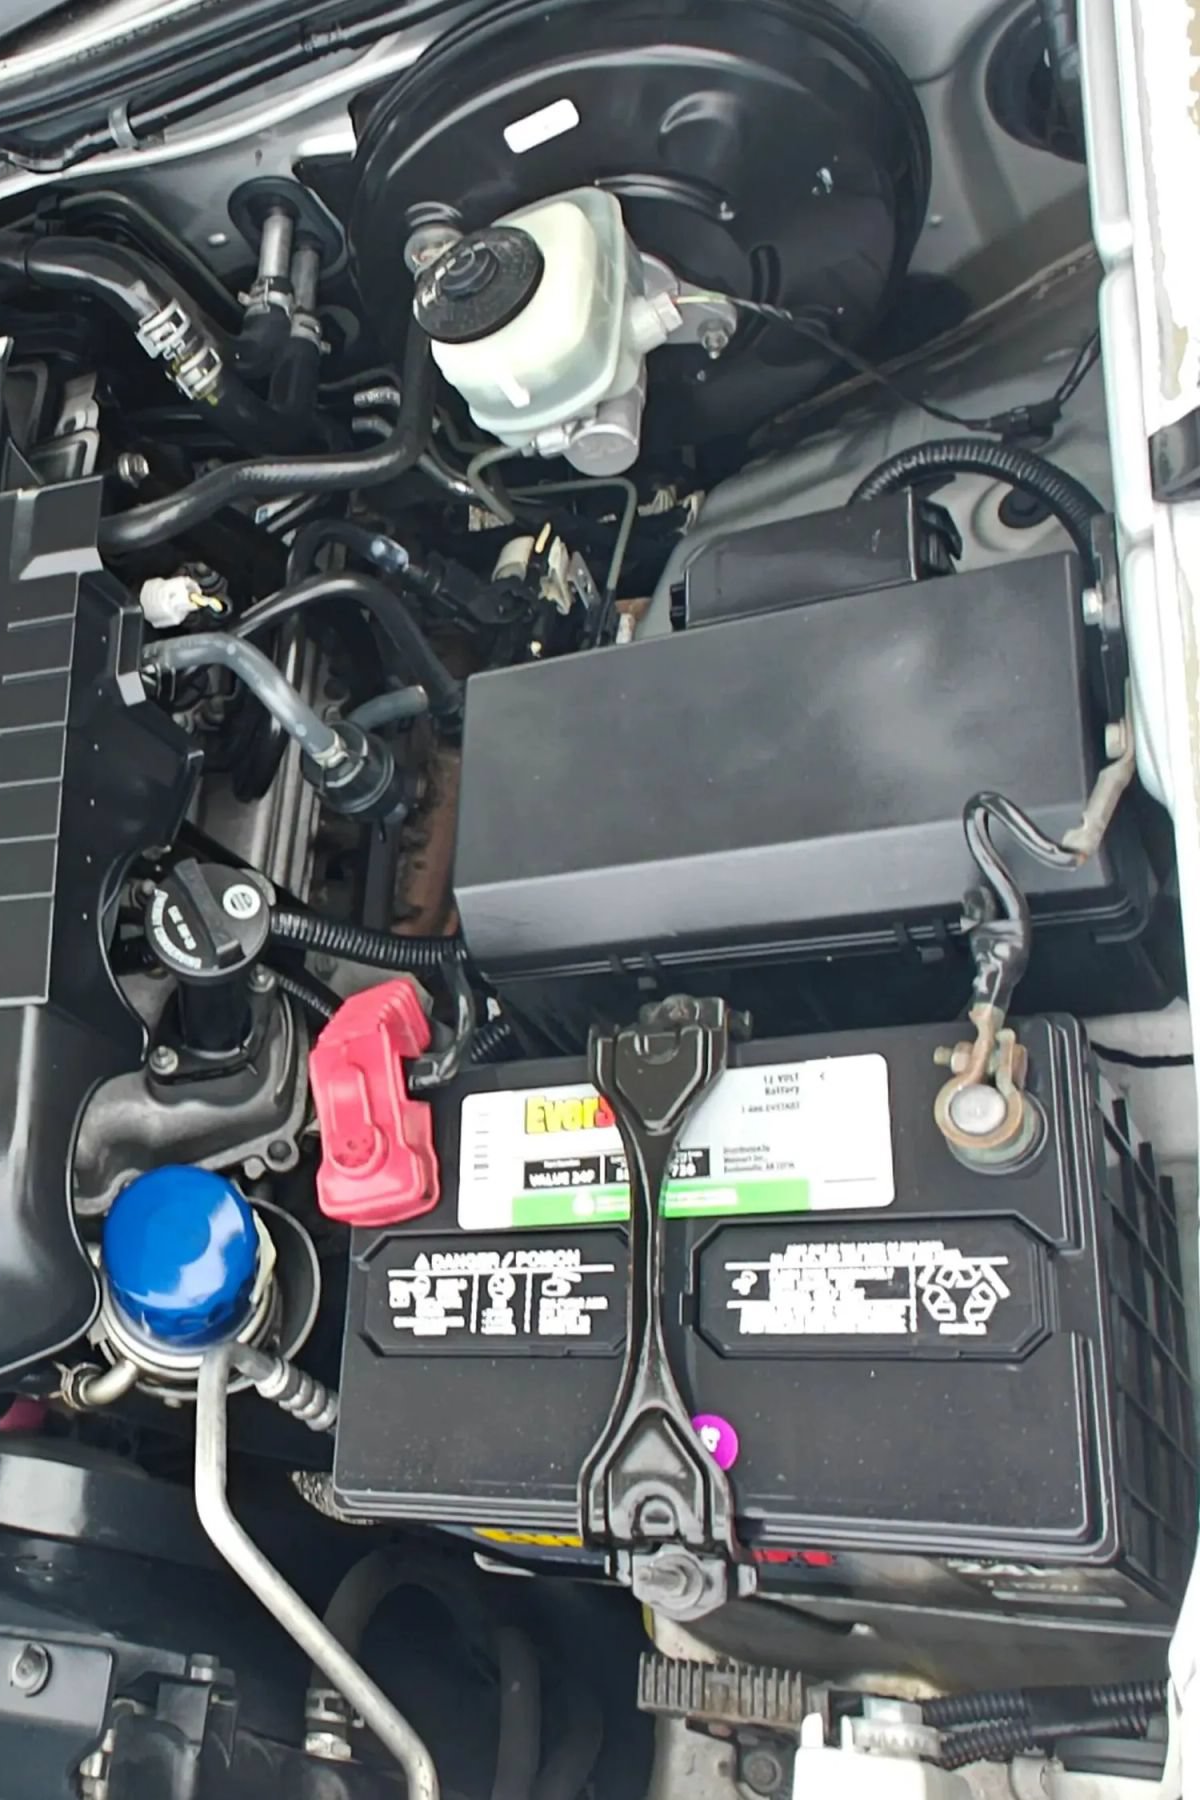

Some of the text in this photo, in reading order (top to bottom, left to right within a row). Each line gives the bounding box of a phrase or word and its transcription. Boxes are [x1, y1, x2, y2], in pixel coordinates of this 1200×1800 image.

[525, 1095, 616, 1135] EverS
[431, 1252, 501, 1271] DANGER
[515, 1249, 581, 1267] POISON
